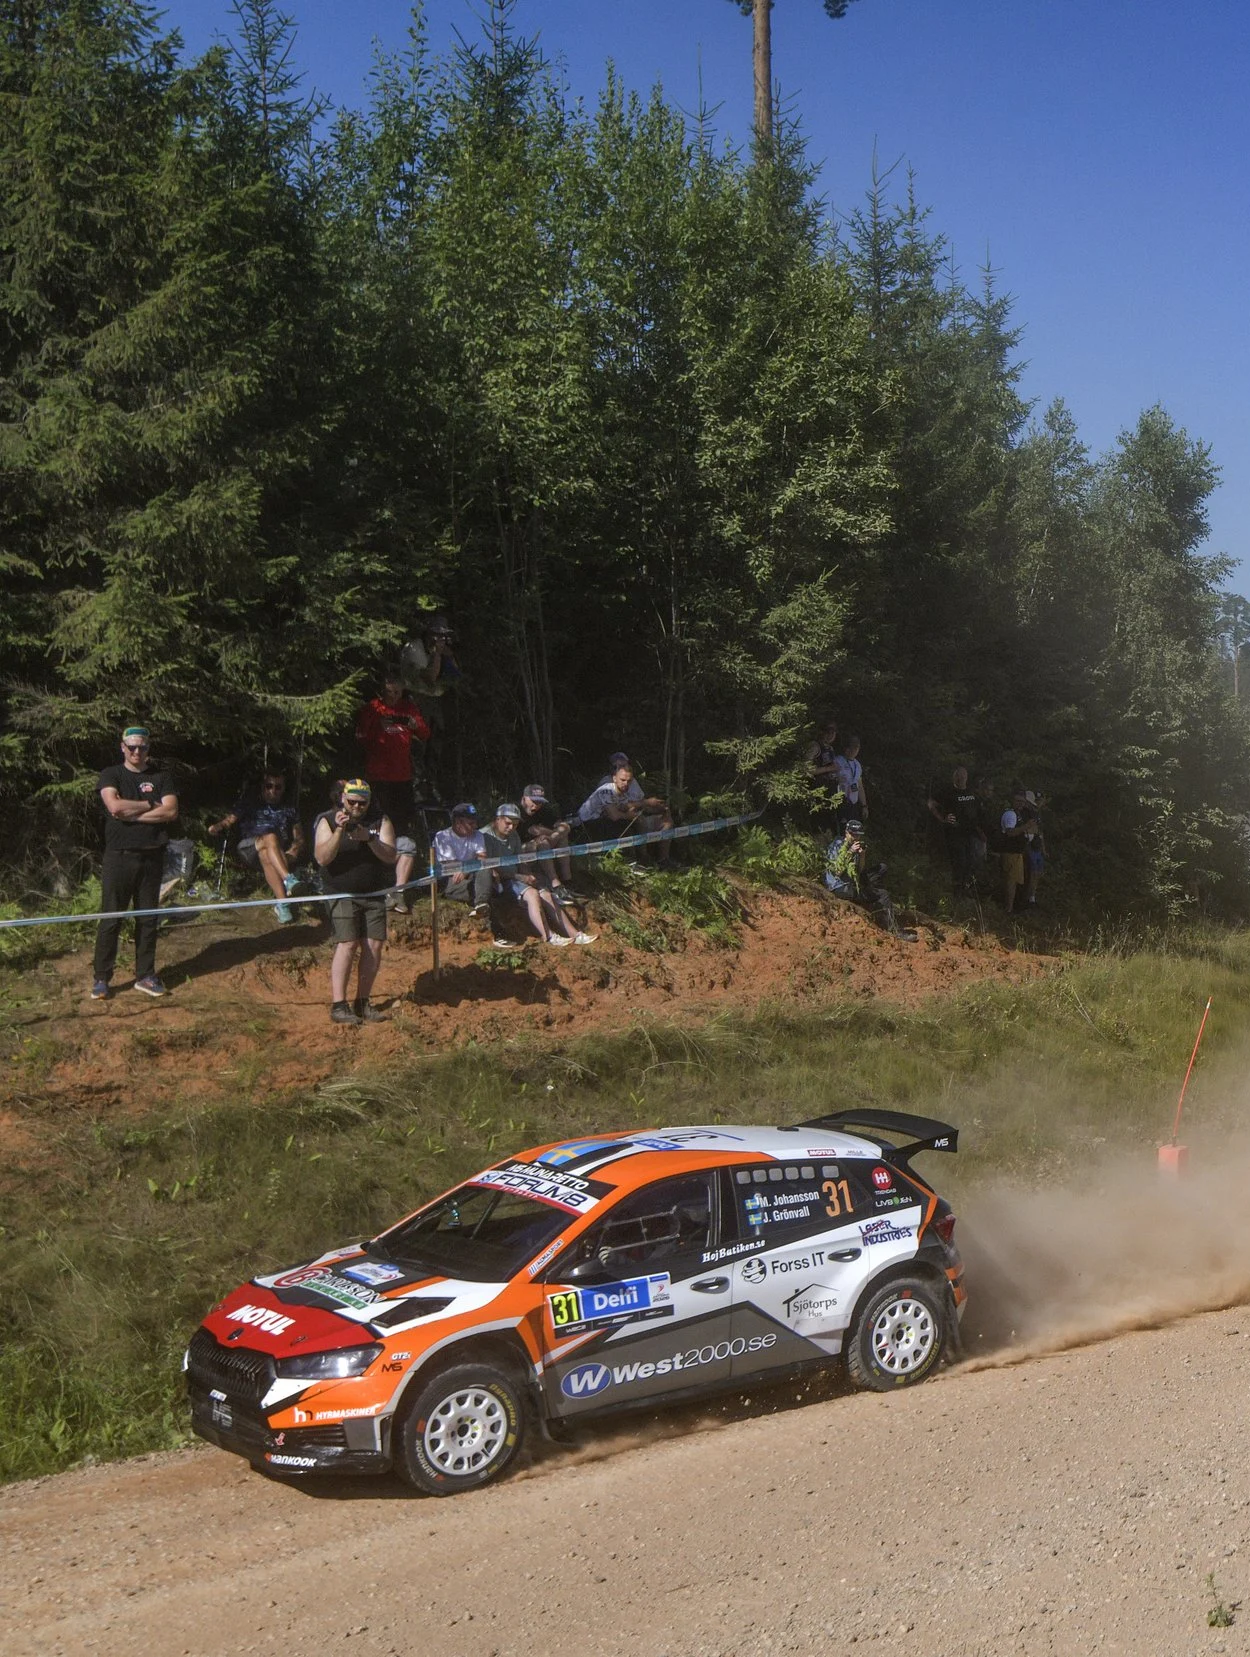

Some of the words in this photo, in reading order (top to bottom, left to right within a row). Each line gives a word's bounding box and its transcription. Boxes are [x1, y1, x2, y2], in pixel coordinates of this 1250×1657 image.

[493, 1174, 589, 1207] FORUM8
[520, 1164, 590, 1191] MUNARETTO
[760, 1197, 772, 1208] M.
[773, 1191, 820, 1207] Johansson
[822, 1180, 855, 1218] 31
[763, 1212, 772, 1223] J.
[772, 1206, 810, 1222] Grönvall
[862, 1228, 912, 1246] INDUSTRIES
[771, 1260, 810, 1275] Forss
[811, 1252, 825, 1267] IT
[225, 1304, 296, 1336] MOTUL
[553, 1292, 579, 1325] 31
[792, 1298, 838, 1315] Sjötorps
[612, 1333, 777, 1385] West2000.se
